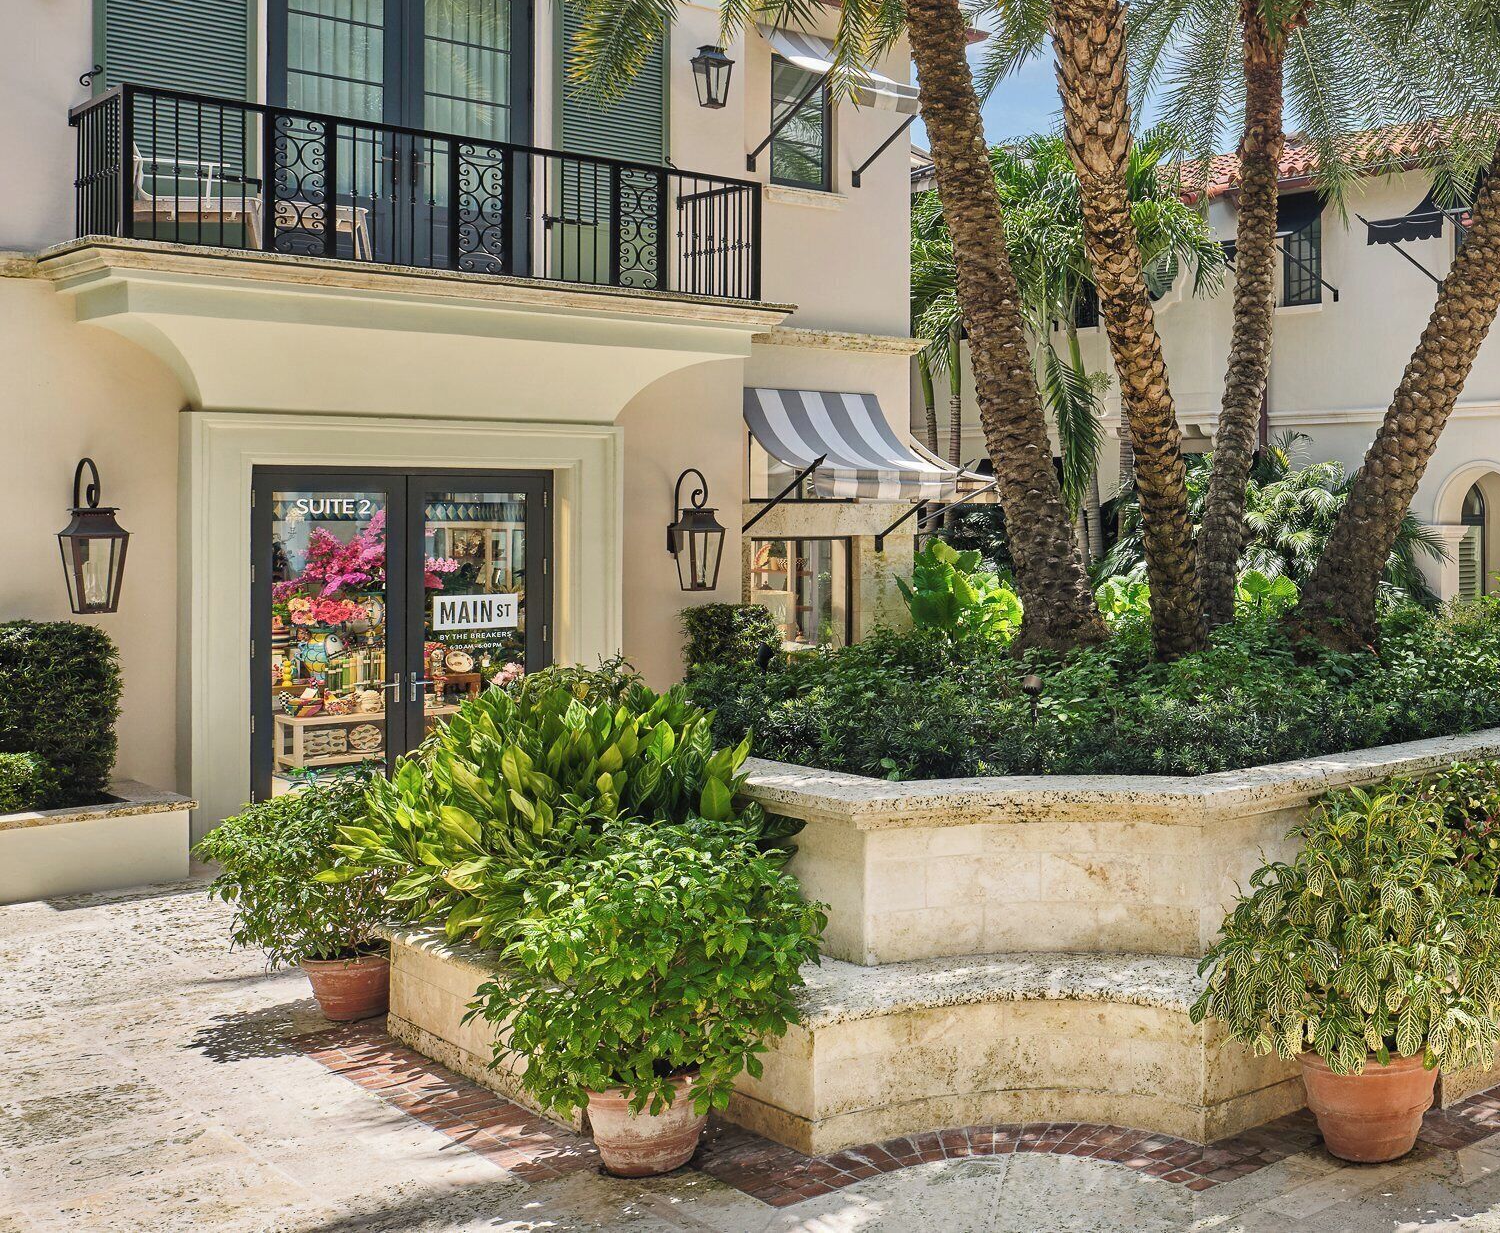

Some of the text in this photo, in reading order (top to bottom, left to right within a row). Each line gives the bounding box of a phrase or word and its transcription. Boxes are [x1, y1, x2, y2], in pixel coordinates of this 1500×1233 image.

[296, 499, 371, 515] SUITE 2
[440, 600, 512, 625] MAIN ST
[470, 631, 512, 639] BREAKERS
